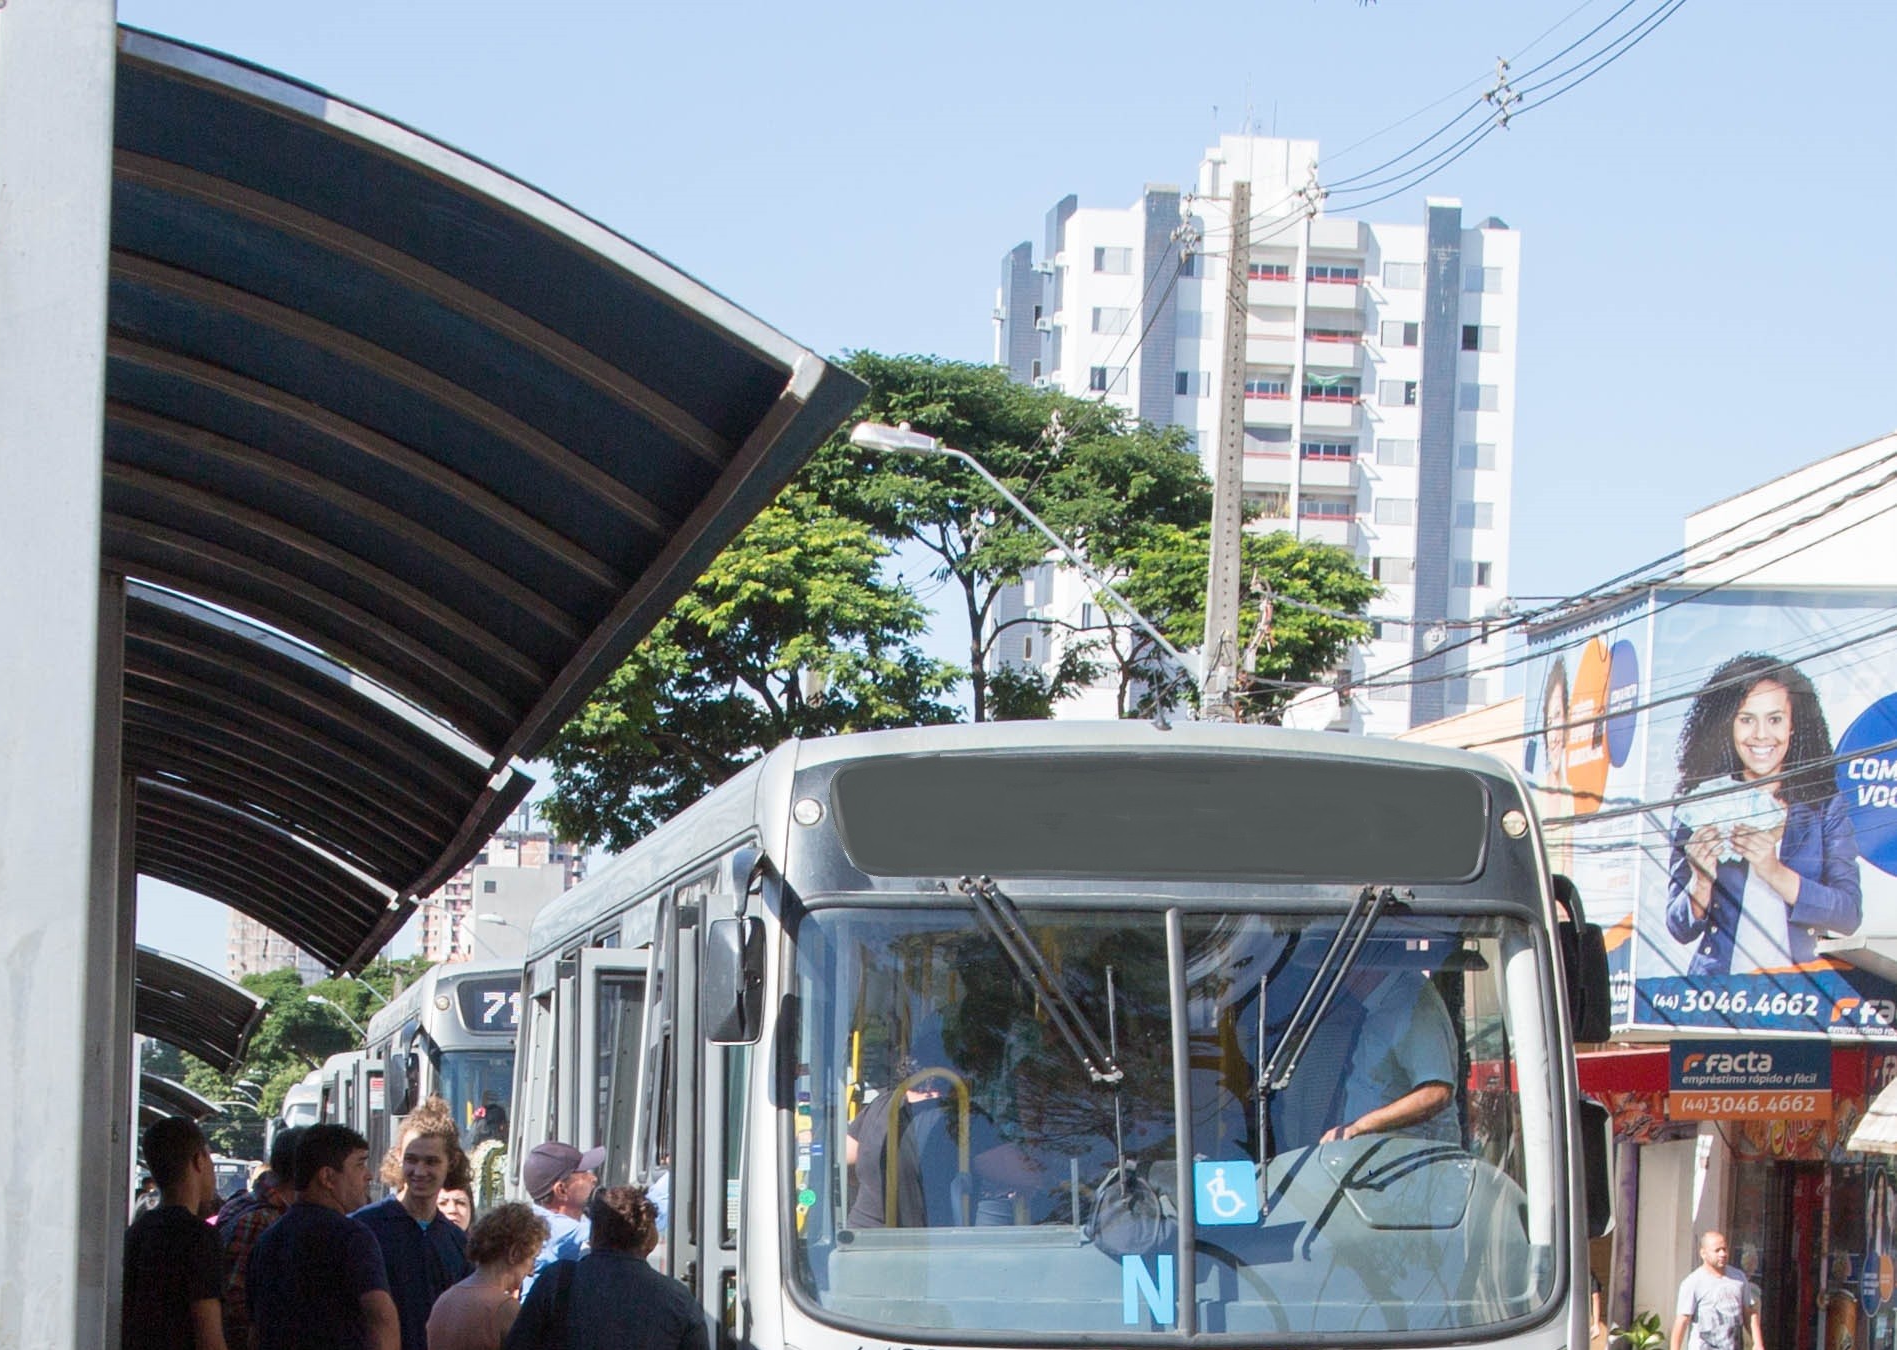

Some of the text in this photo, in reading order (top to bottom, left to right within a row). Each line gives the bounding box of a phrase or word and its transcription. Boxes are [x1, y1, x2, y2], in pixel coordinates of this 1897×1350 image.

[1653, 993, 1679, 1009] (44)
[1681, 990, 1819, 1016] 3046.4662
[1706, 1051, 1773, 1073] facta
[1682, 1074, 1746, 1086] empréstimo
[1748, 1073, 1783, 1085] rápido
[1793, 1073, 1818, 1085] fácil
[1122, 1254, 1174, 1324] N
